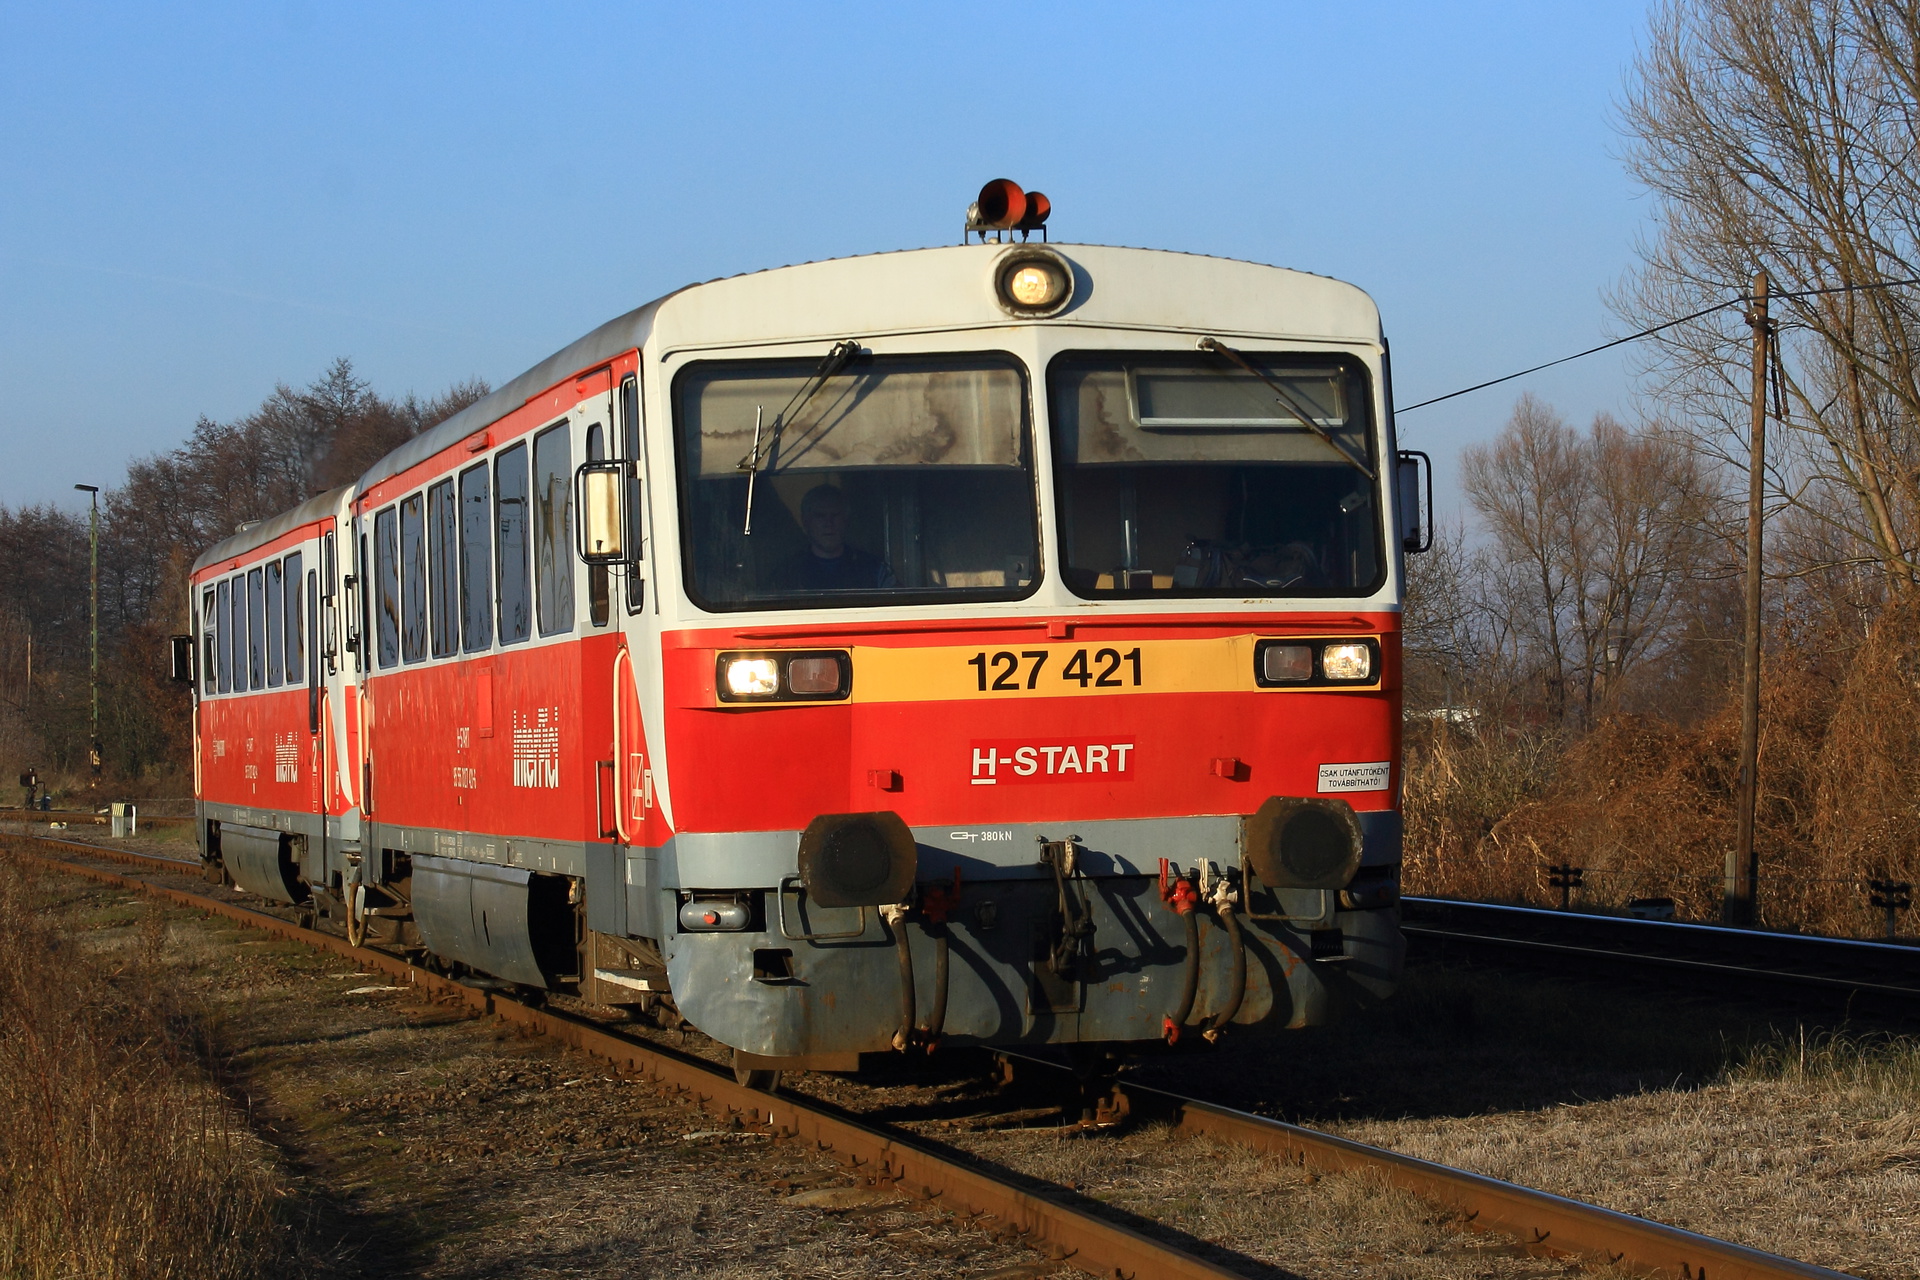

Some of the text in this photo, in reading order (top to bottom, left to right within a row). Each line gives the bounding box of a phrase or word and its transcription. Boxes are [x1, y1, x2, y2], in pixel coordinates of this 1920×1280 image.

[968, 647, 1142, 691] 127 421
[971, 743, 1134, 785] H-START
[1320, 769, 1338, 777] CSAK
